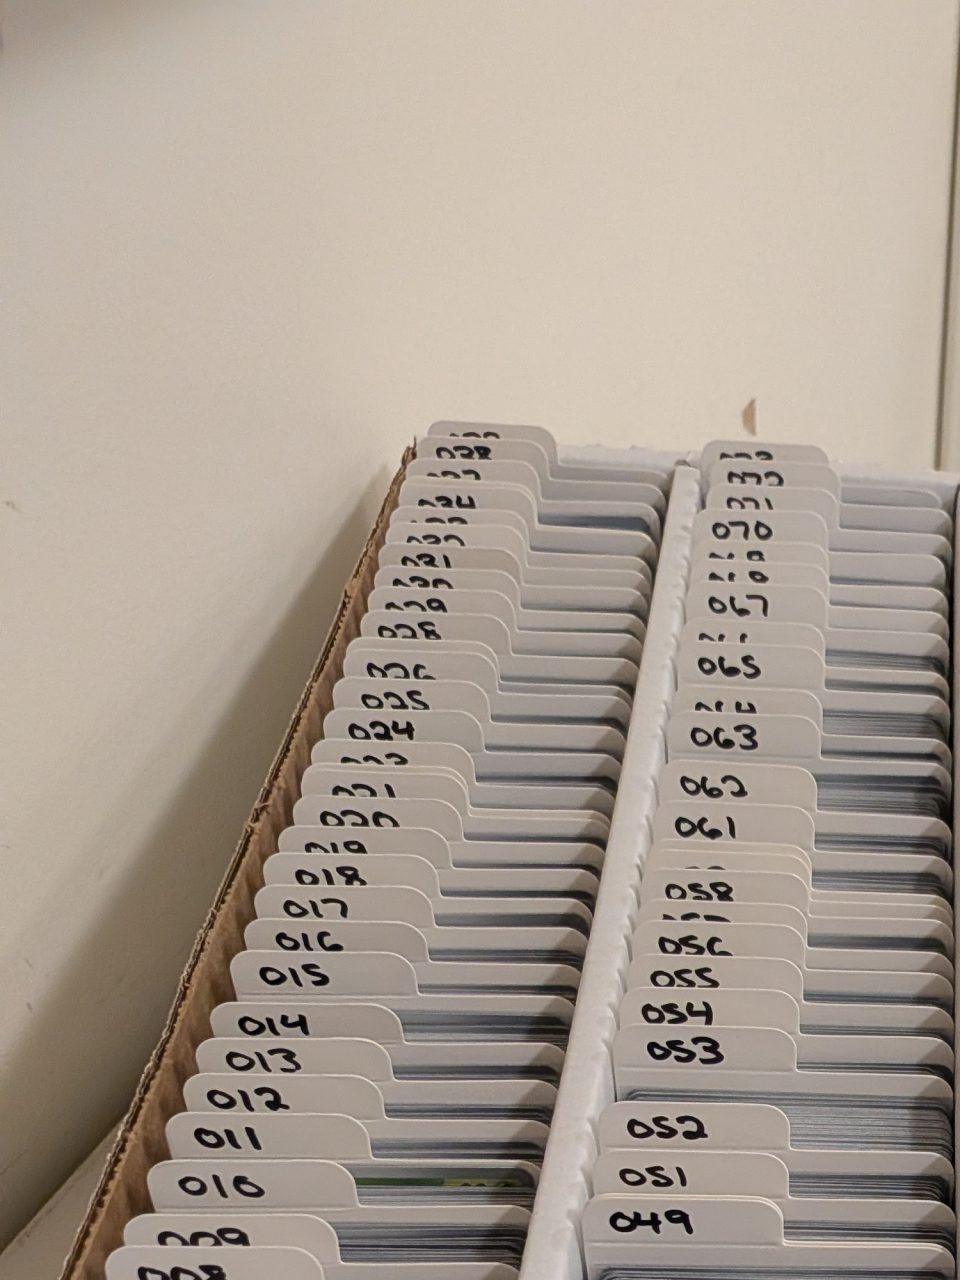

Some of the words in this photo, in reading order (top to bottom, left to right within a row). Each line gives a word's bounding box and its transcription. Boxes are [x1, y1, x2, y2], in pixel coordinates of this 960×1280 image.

[712, 520, 773, 541] 070
[708, 594, 768, 617] 067
[378, 621, 441, 640] 028
[698, 655, 761, 679] 065
[361, 690, 430, 710] 025
[348, 721, 415, 741] 024
[690, 724, 758, 751] 063
[680, 775, 748, 799] 062
[320, 809, 400, 827] 020
[674, 816, 736, 840] 061
[295, 866, 367, 886] 018
[665, 881, 734, 902] 058
[283, 898, 348, 918] 017
[276, 931, 344, 951] 016
[658, 935, 733, 957] 056
[259, 963, 330, 987] 015
[650, 967, 720, 988] 055
[238, 1014, 310, 1036] 014
[641, 1001, 714, 1026] 054
[226, 1048, 301, 1073] 013
[646, 1036, 724, 1065] 053
[207, 1087, 290, 1112] 012
[194, 1127, 261, 1150] 011
[627, 1115, 709, 1140] 052
[178, 1174, 265, 1198] 010
[618, 1165, 688, 1189] 051
[608, 1209, 695, 1235] 049
